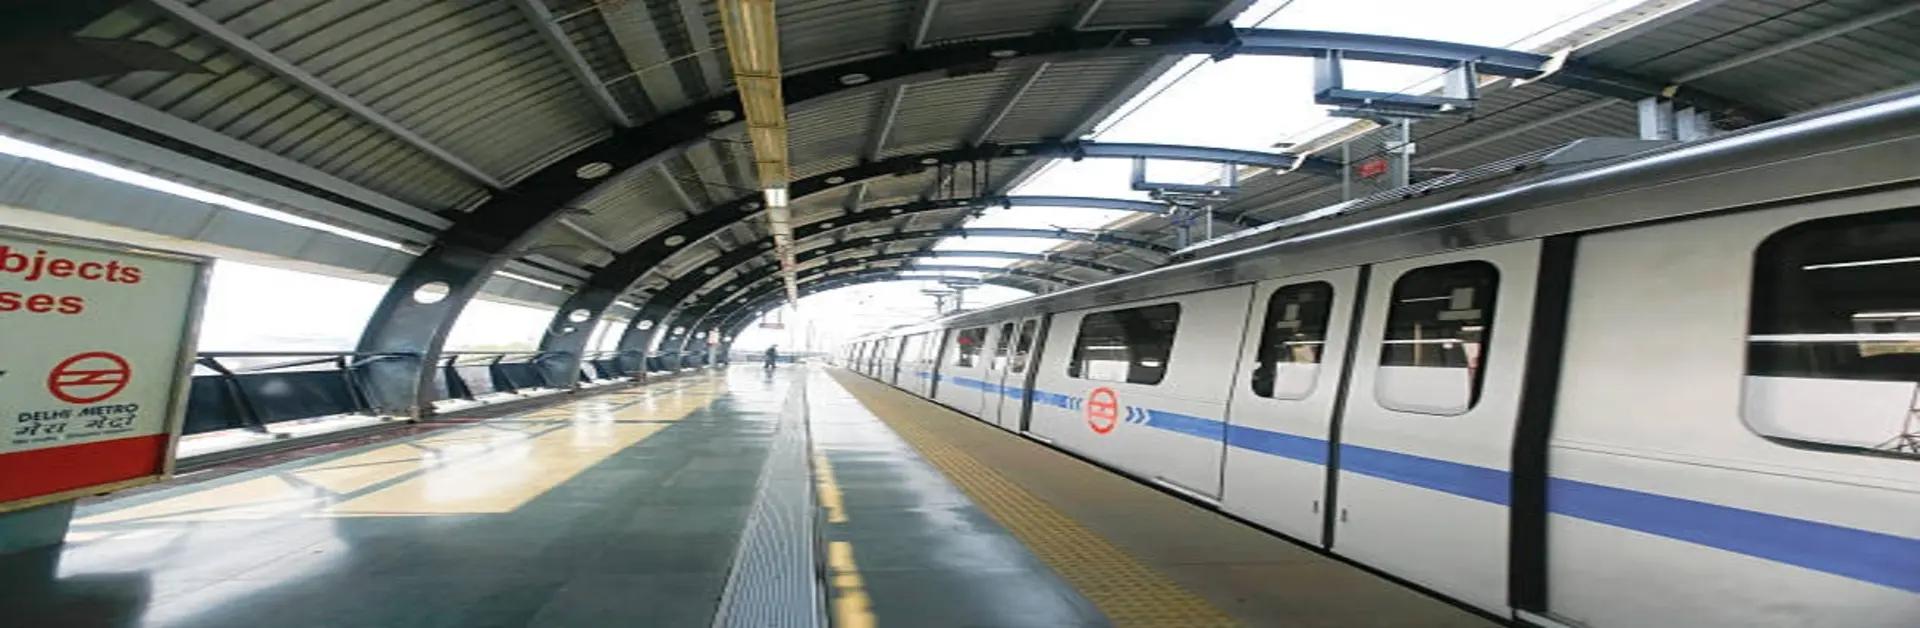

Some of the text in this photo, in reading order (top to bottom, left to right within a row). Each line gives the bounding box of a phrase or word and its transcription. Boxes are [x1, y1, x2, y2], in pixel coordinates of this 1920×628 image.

[0, 246, 142, 284] bjects
[18, 403, 139, 423] DELHI METRO
